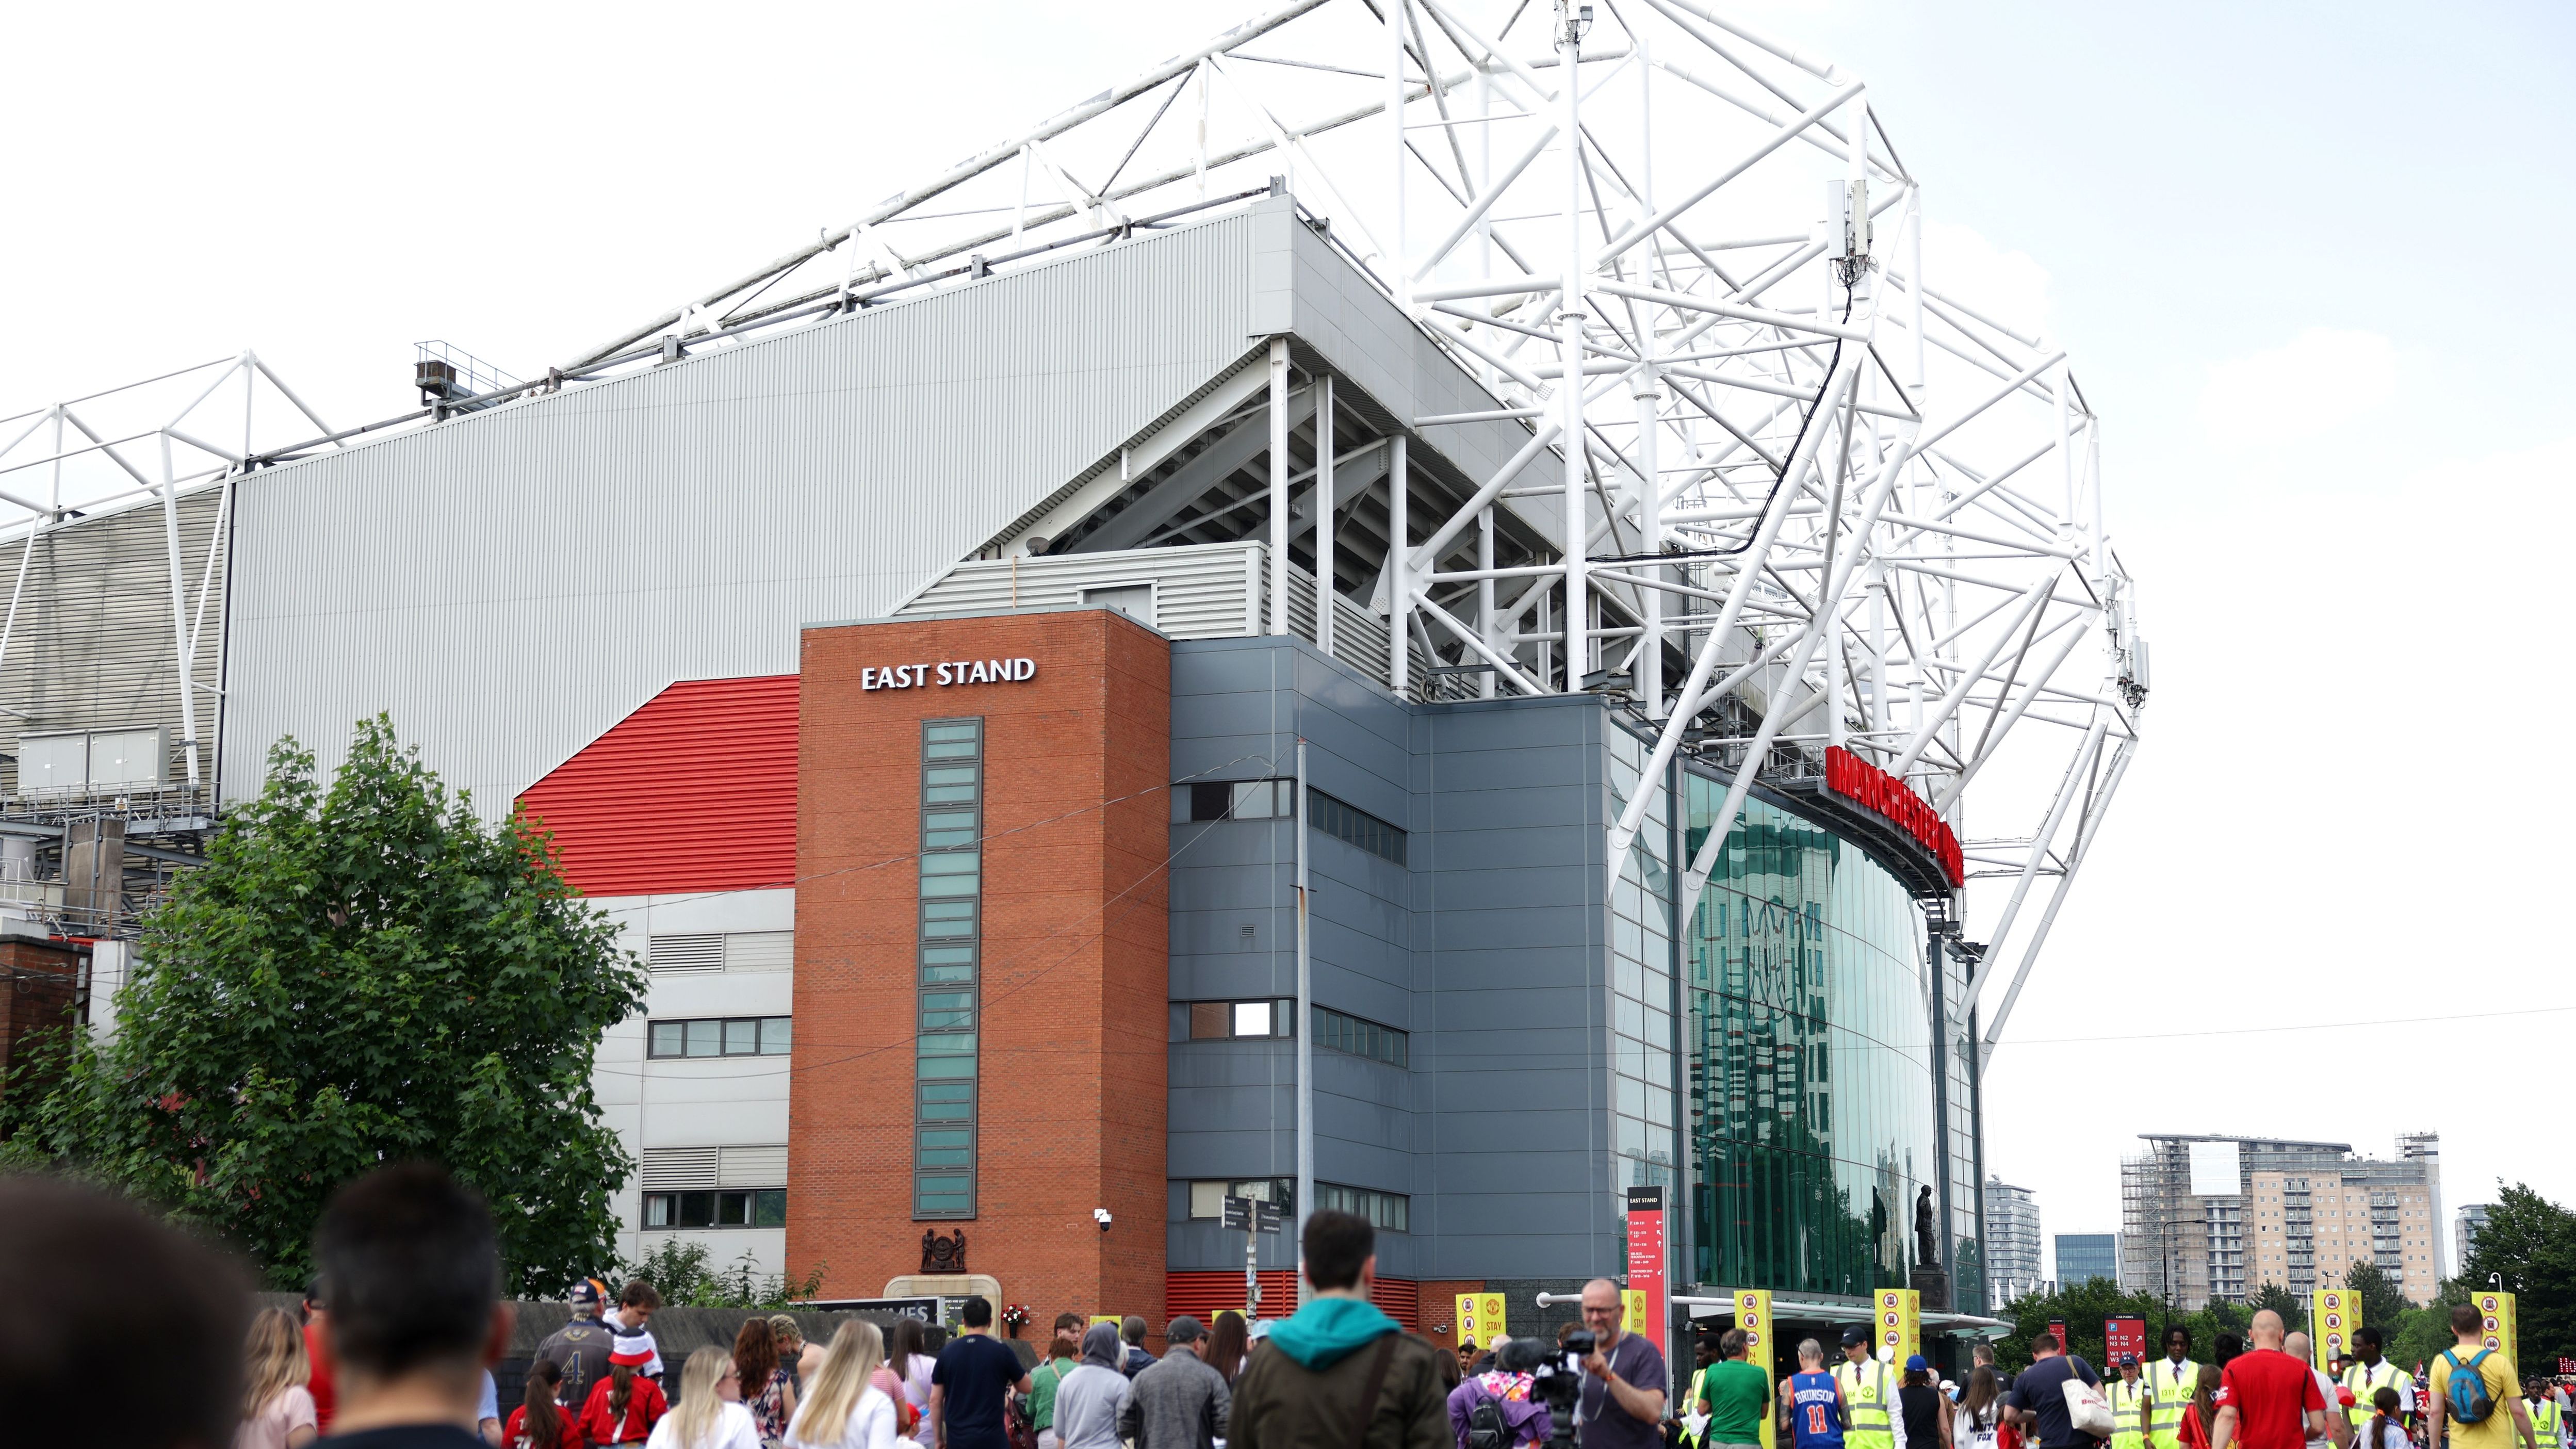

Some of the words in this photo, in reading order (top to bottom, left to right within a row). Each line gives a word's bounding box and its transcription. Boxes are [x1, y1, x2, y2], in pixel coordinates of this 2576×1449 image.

[861, 664, 929, 690] EAST
[937, 658, 1036, 686] STAND
[1826, 745, 1939, 851] MANCHESTER
[1486, 1322, 1502, 1331] STAY
[1634, 1318, 1644, 1328] STAY
[1910, 1319, 1918, 1329] STAY
[2352, 1321, 2360, 1330] STAY
[1910, 1334, 1919, 1343] SAFE
[561, 1350, 584, 1385] 4
[1795, 1389, 1835, 1405] BRUNSON
[1807, 1405, 1828, 1435] 11
[1977, 1432, 1993, 1442] FOX
